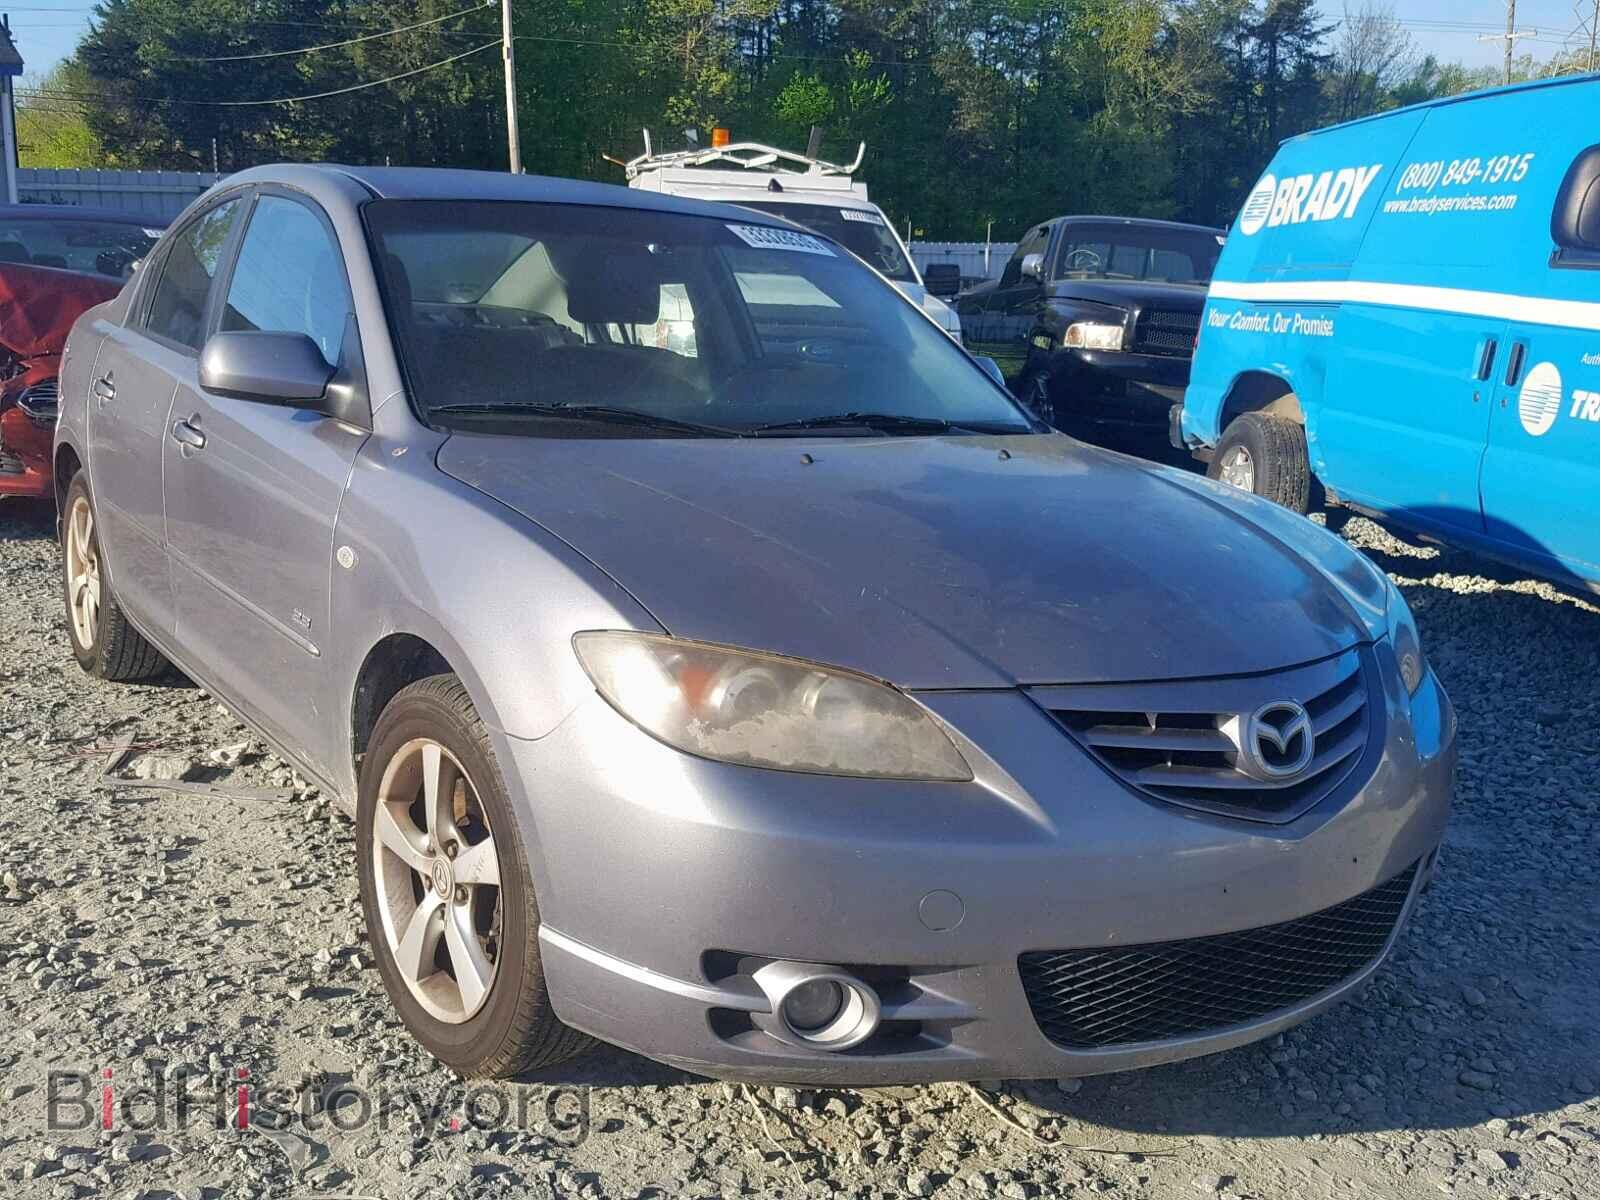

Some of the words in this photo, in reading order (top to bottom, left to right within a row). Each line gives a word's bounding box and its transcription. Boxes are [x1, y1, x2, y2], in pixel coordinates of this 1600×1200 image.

[1396, 160, 1444, 195] (800)
[1441, 153, 1535, 186] 849-1915
[1267, 164, 1383, 228] BRADY
[1383, 193, 1517, 216] www.bradyservices.com
[1207, 307, 1231, 328] Your
[1272, 312, 1293, 333] Our
